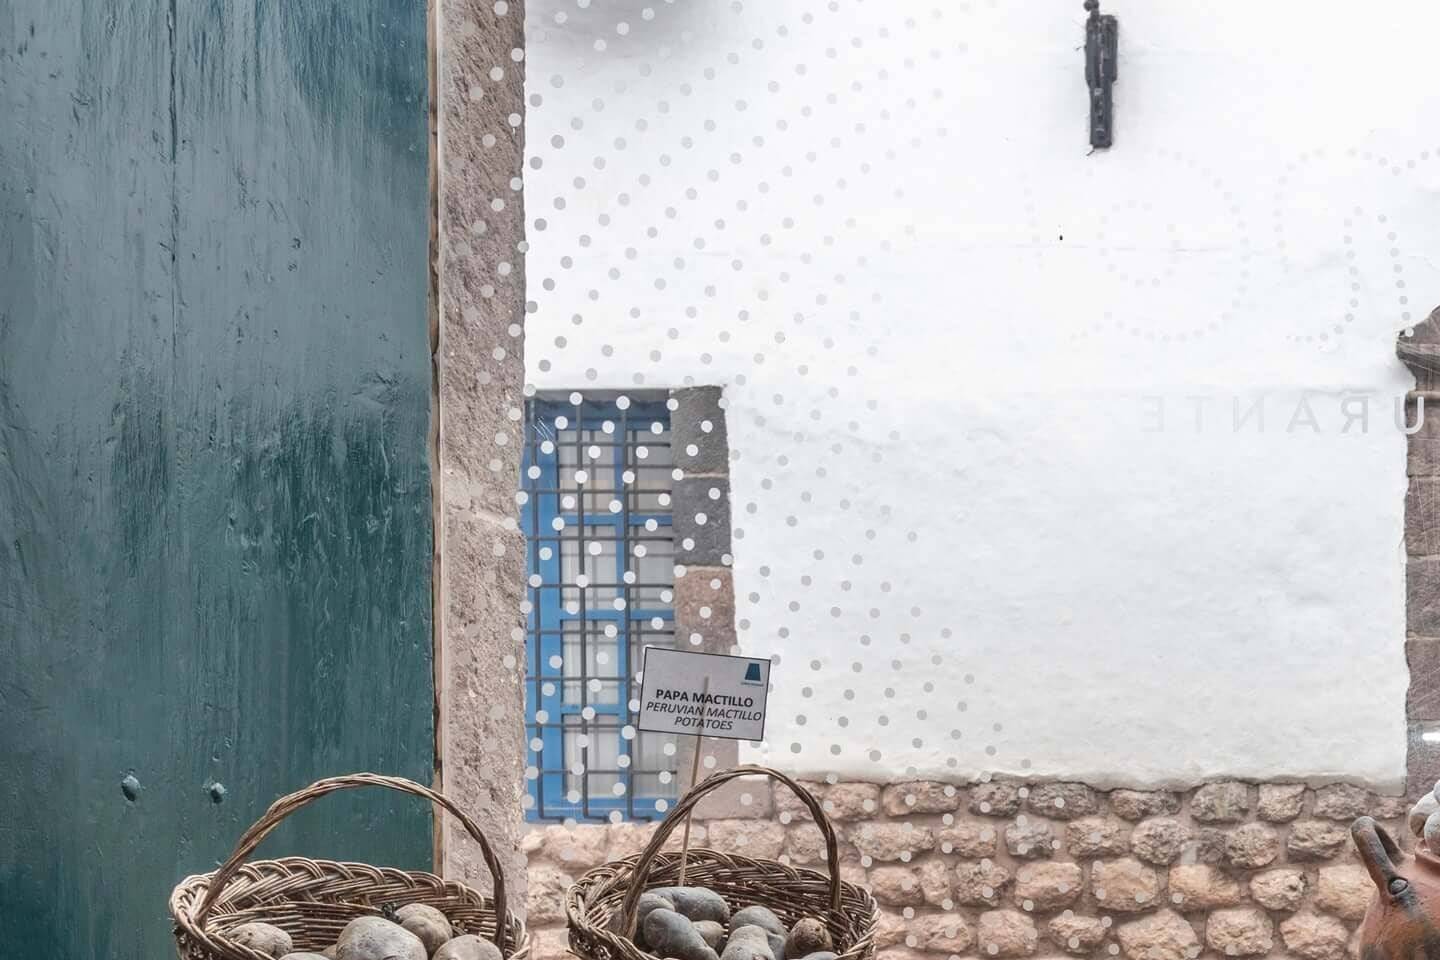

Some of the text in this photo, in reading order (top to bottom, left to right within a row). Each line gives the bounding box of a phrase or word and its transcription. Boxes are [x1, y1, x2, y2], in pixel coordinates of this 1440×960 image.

[656, 689, 753, 707] PAPA MACTILLO
[646, 702, 761, 721] PERUVIAN MACTILLO
[675, 717, 733, 730] POTATOES
